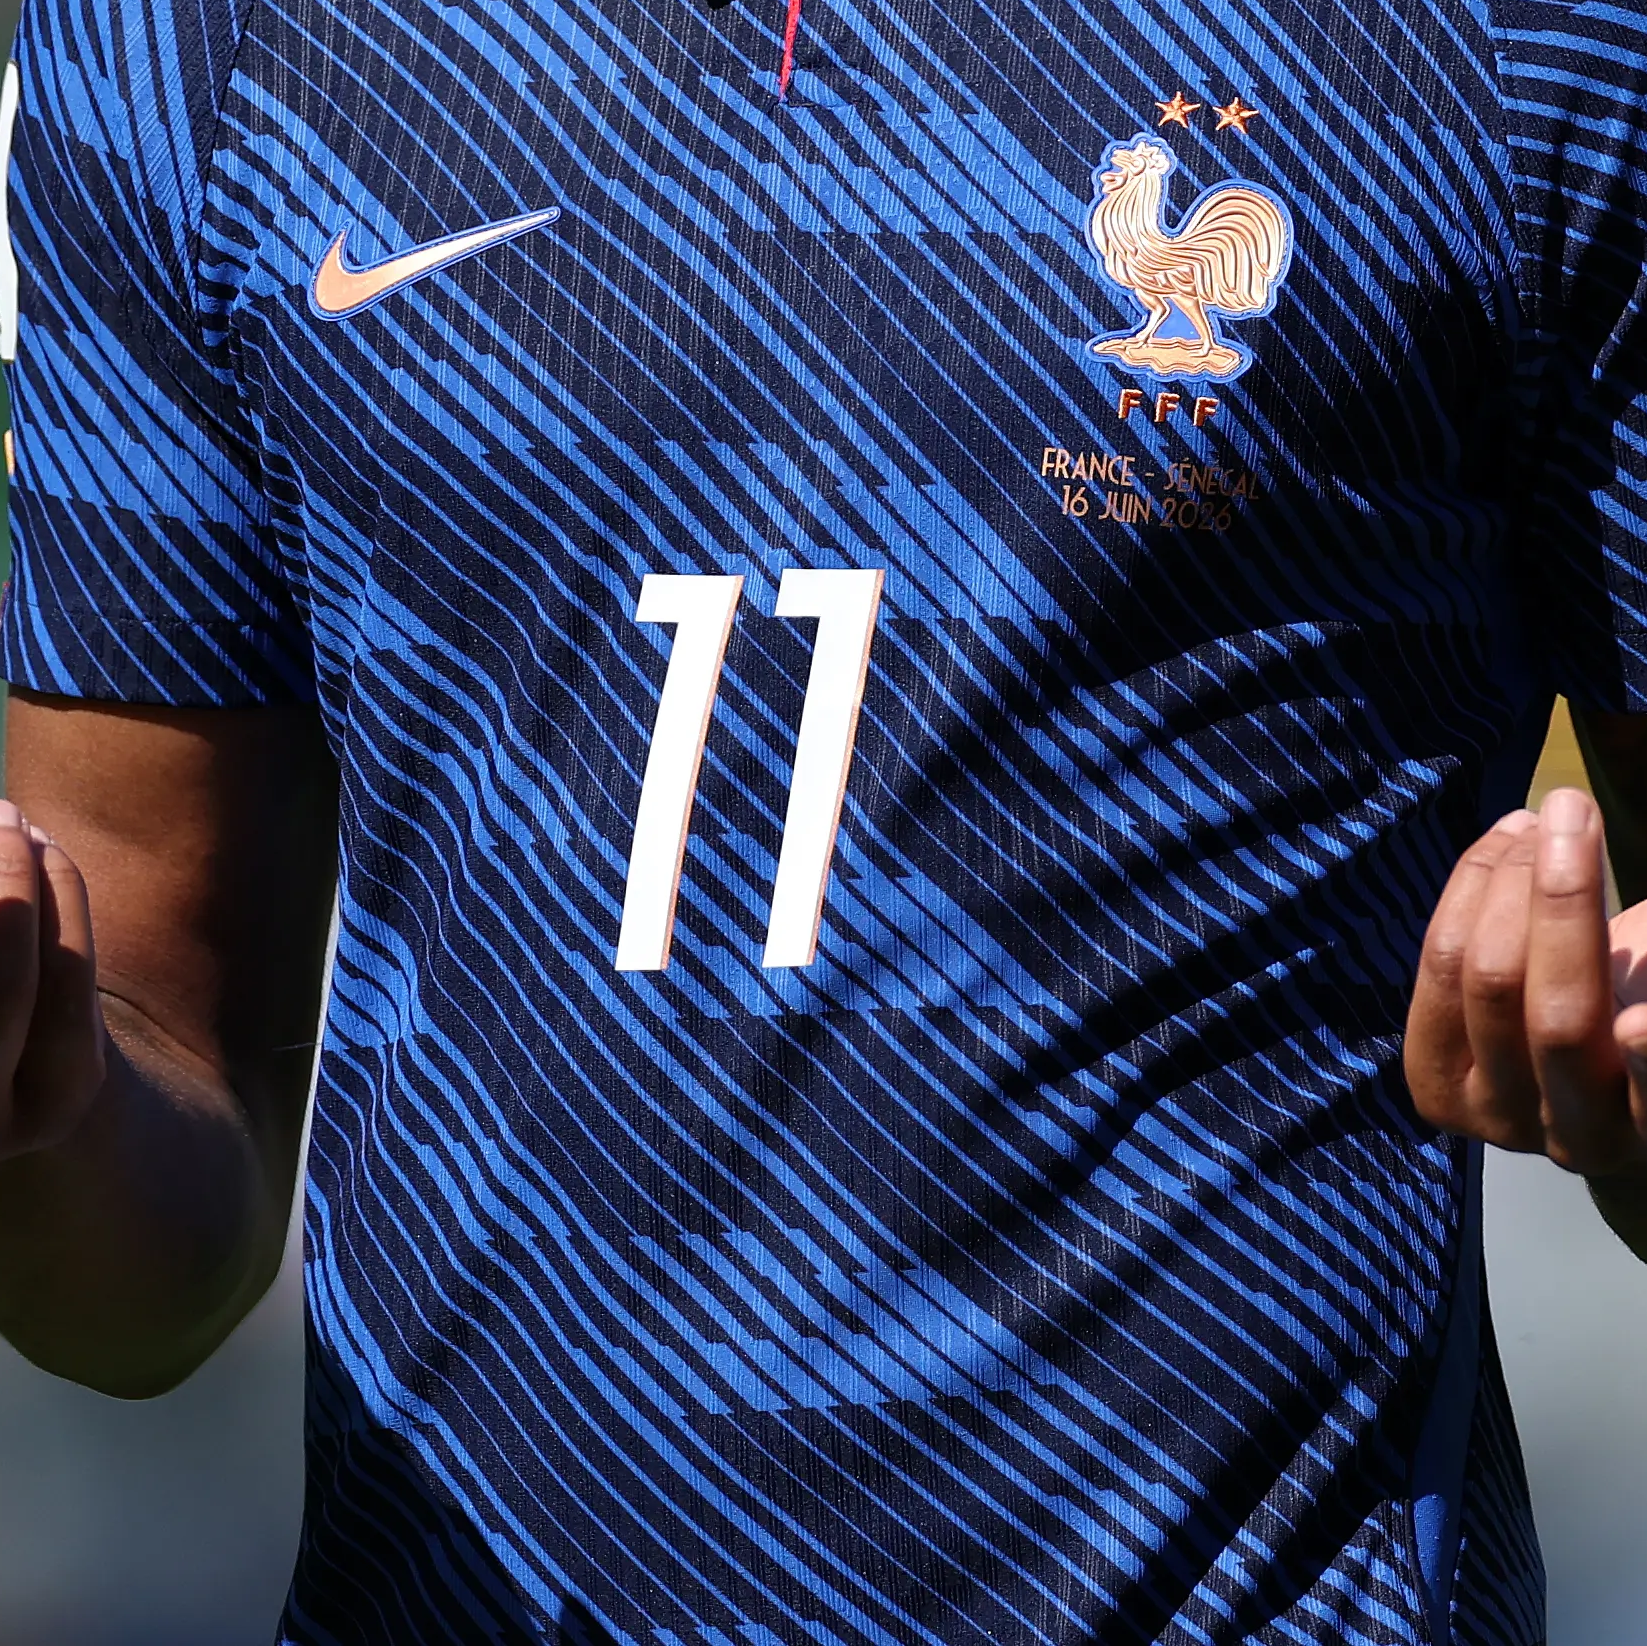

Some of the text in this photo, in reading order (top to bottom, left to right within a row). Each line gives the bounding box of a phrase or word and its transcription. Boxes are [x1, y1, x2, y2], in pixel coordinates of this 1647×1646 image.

[1041, 447, 1136, 487] FRANCE
[1061, 484, 1233, 532] 16 JUIN 2026
[615, 568, 886, 971] 11
